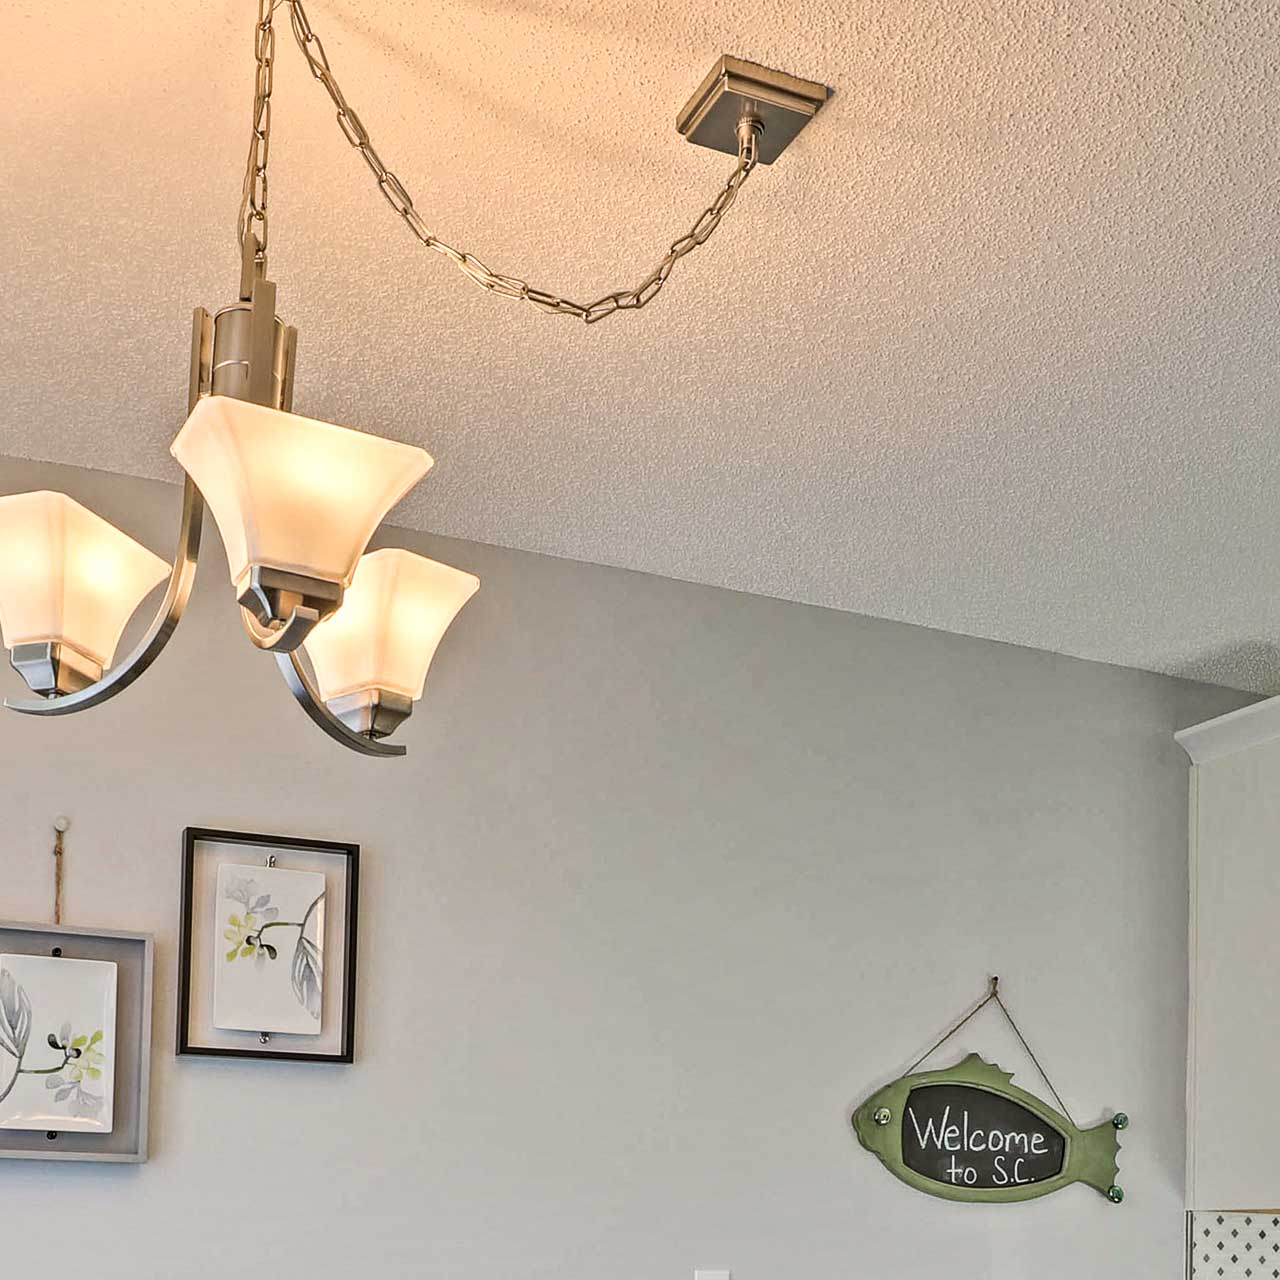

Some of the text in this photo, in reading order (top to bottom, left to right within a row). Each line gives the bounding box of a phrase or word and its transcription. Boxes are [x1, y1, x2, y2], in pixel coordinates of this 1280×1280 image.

[909, 1105, 1049, 1154] Welcome
[946, 1154, 1035, 1184] to S.C.
